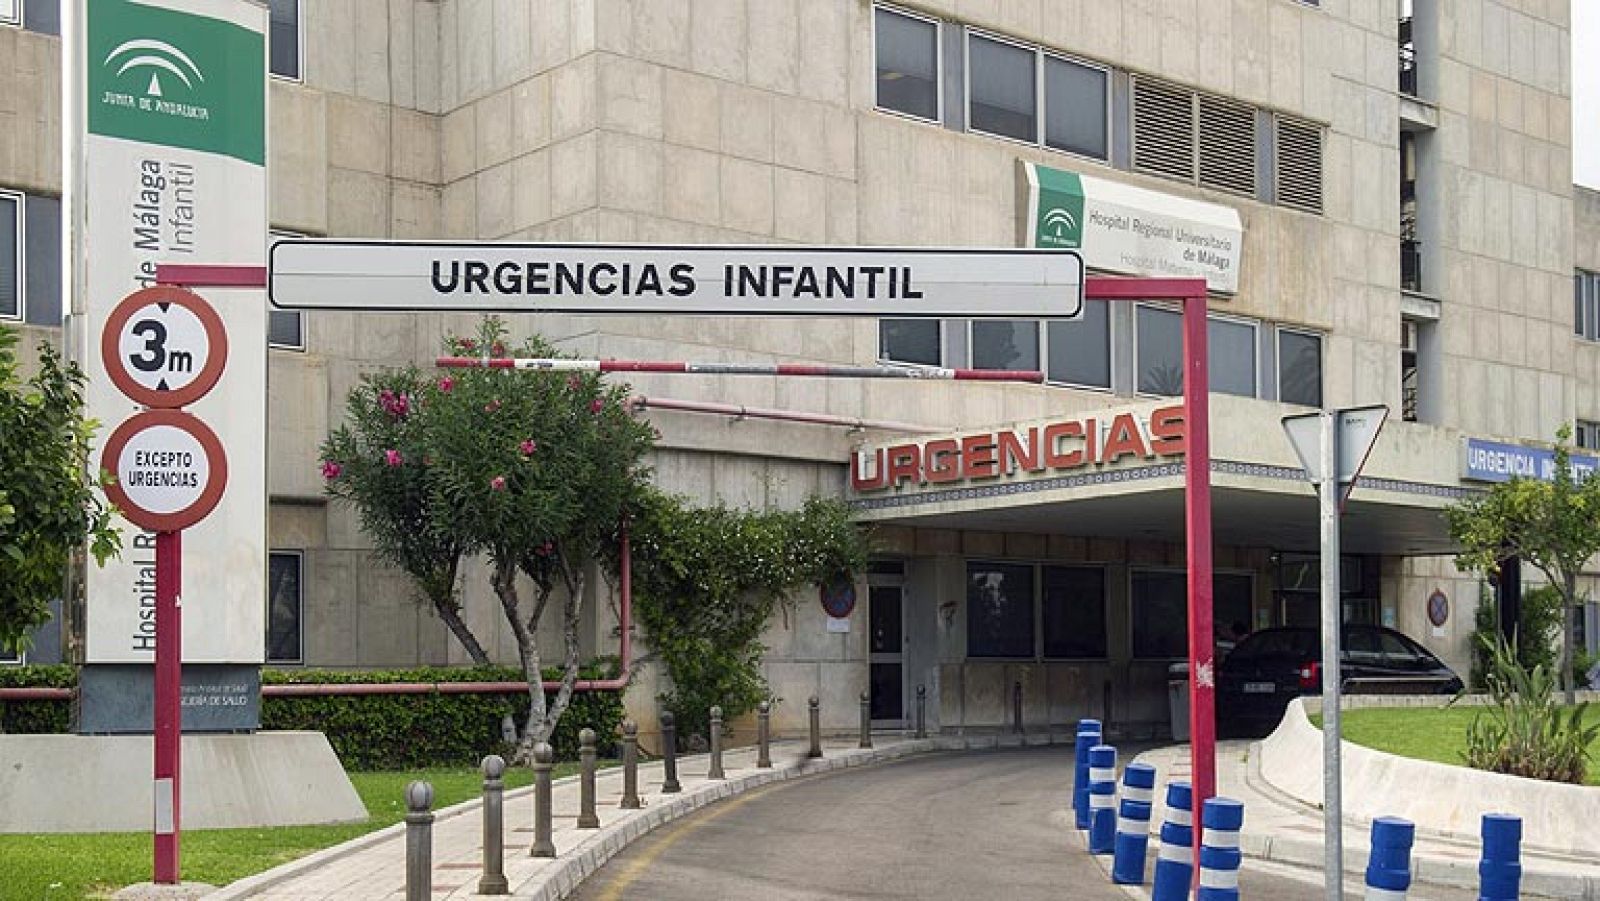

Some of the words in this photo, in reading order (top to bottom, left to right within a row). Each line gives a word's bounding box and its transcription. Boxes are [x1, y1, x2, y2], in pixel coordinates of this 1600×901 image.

[133, 160, 166, 251] Málaga
[168, 162, 194, 252] Infantil
[1089, 210, 1130, 230] Hospital
[1133, 218, 1173, 240] Regional
[1176, 228, 1232, 250] Universitario
[1183, 248, 1196, 262] de
[432, 260, 696, 297] URGENCIAS
[724, 264, 924, 299] INFANTIL
[134, 450, 193, 468] EXCEPTO
[851, 405, 1186, 491] URGENCIAS
[128, 470, 199, 488] URGENCIAS
